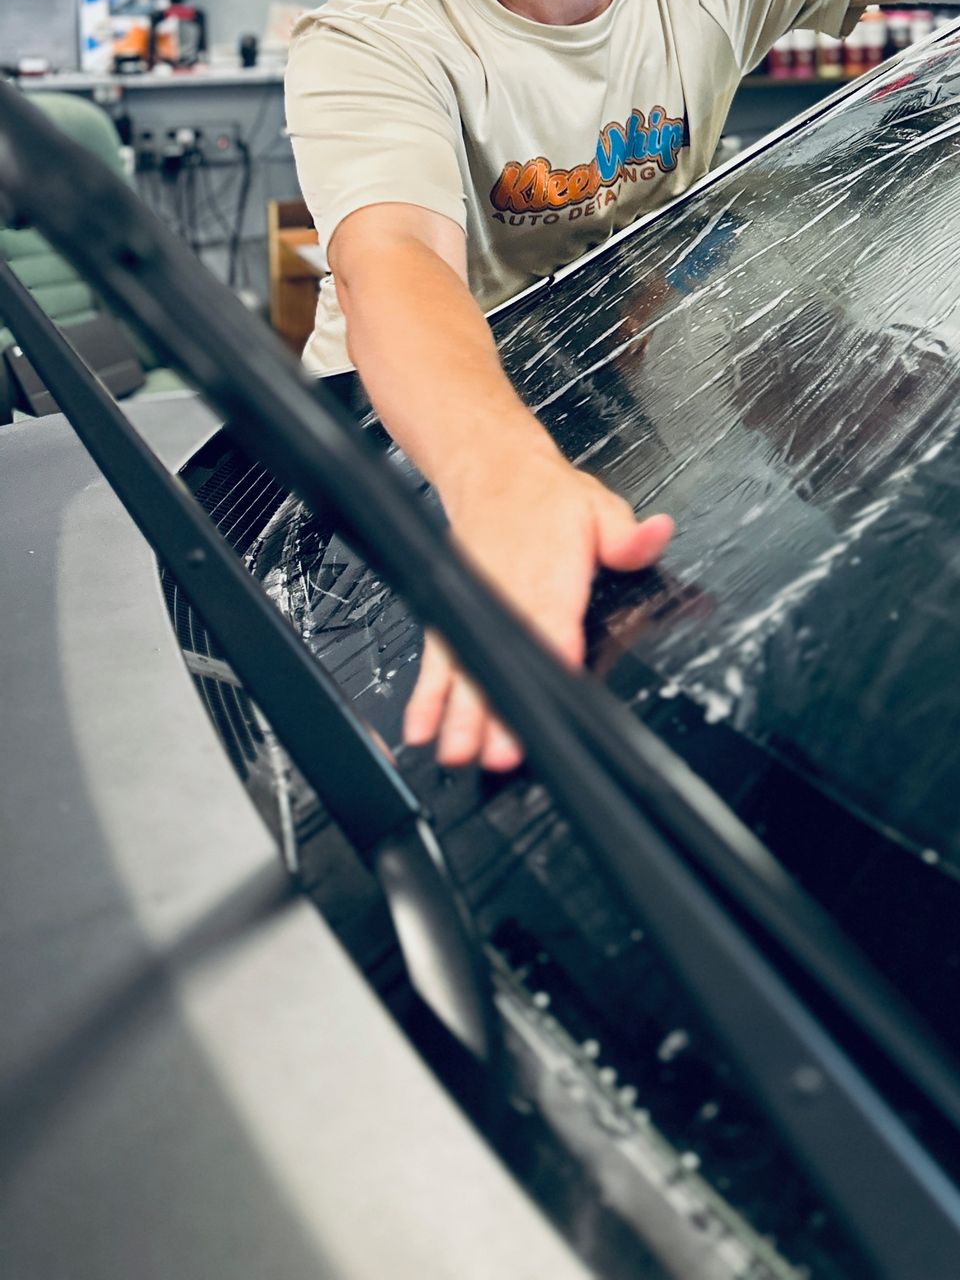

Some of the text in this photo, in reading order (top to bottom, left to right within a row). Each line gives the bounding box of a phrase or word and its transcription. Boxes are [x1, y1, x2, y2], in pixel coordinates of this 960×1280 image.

[490, 105, 684, 214] KleenWhip
[491, 165, 657, 227] AUTO DETANG
